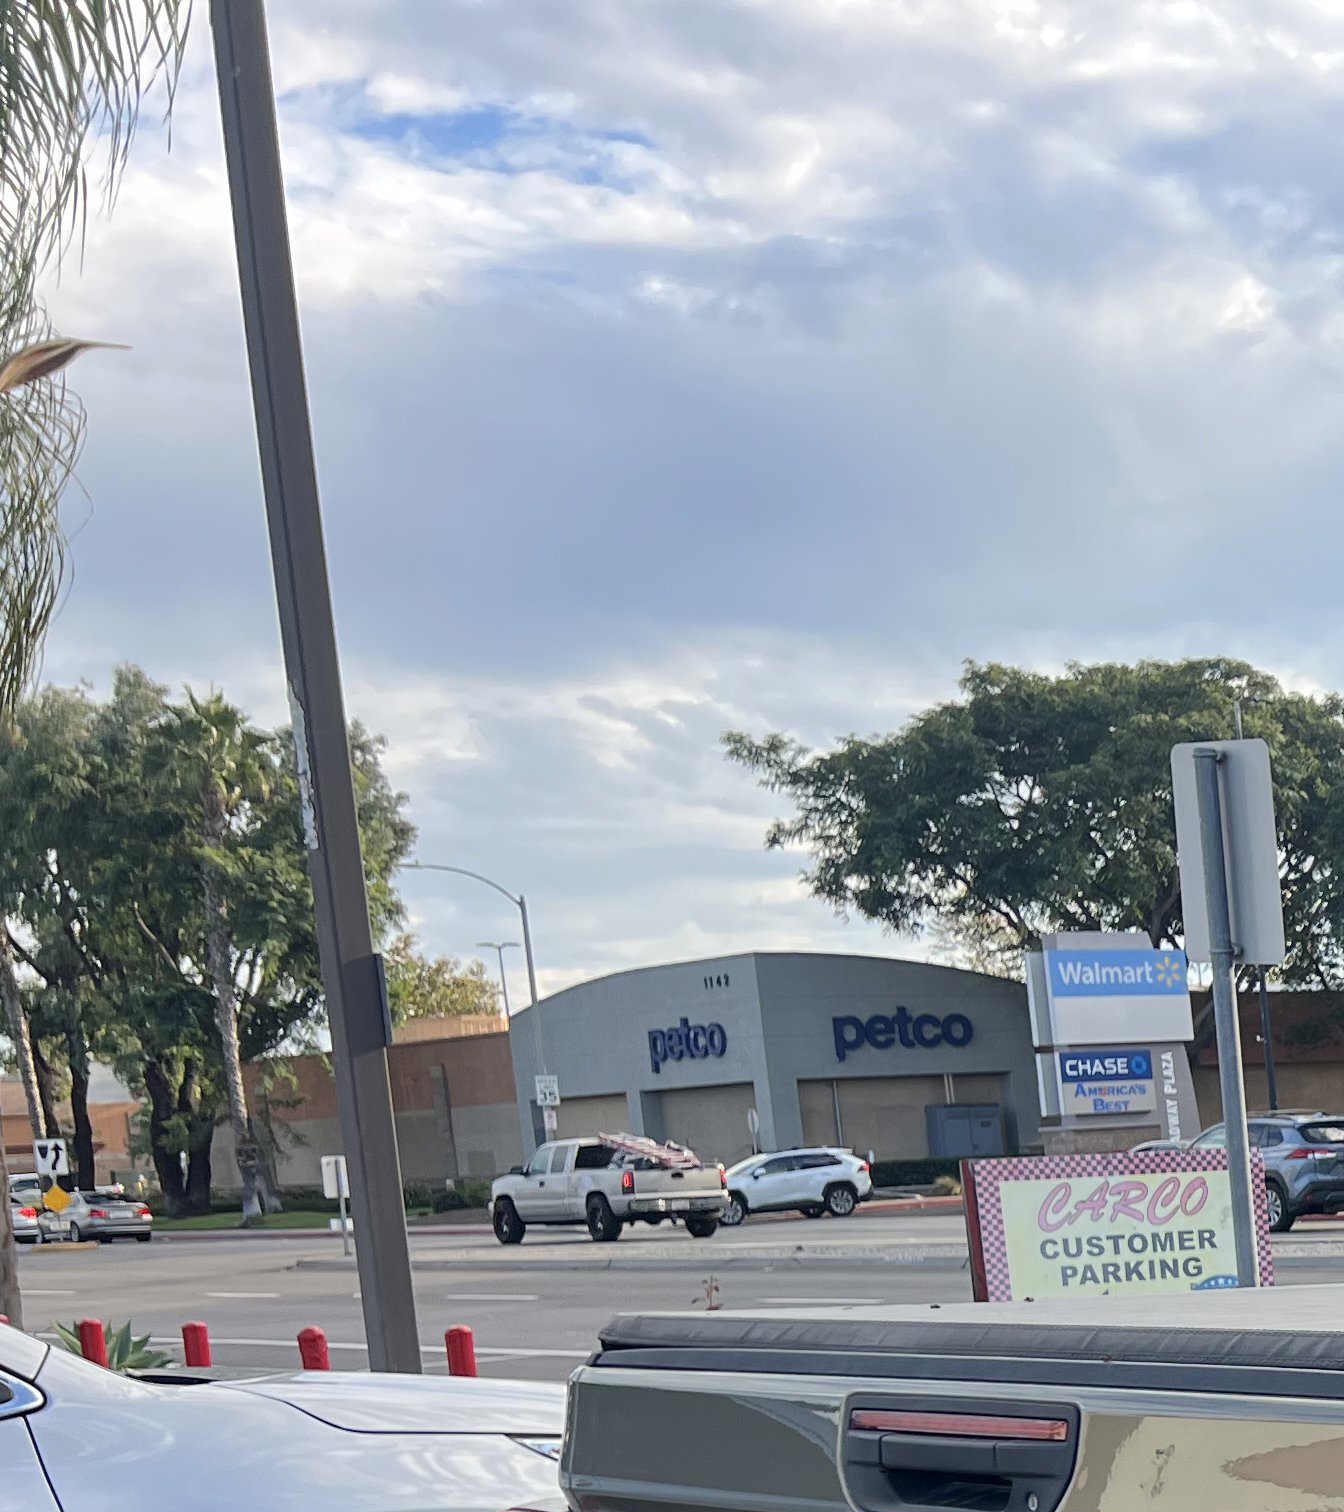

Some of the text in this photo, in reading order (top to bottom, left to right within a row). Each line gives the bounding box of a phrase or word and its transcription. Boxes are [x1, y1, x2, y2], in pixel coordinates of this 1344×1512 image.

[704, 965, 730, 989] 1142
[1058, 961, 1153, 985] Walmart
[648, 1017, 727, 1074] petco
[832, 1006, 973, 1063] petco
[1065, 1058, 1129, 1076] CHASE
[1160, 1051, 1177, 1095] PLAZA
[1093, 1098, 1130, 1112] BEST
[1038, 1176, 1208, 1233] CARCO
[1040, 1229, 1217, 1259] CUSTOMER
[1060, 1256, 1203, 1287] PARKING
